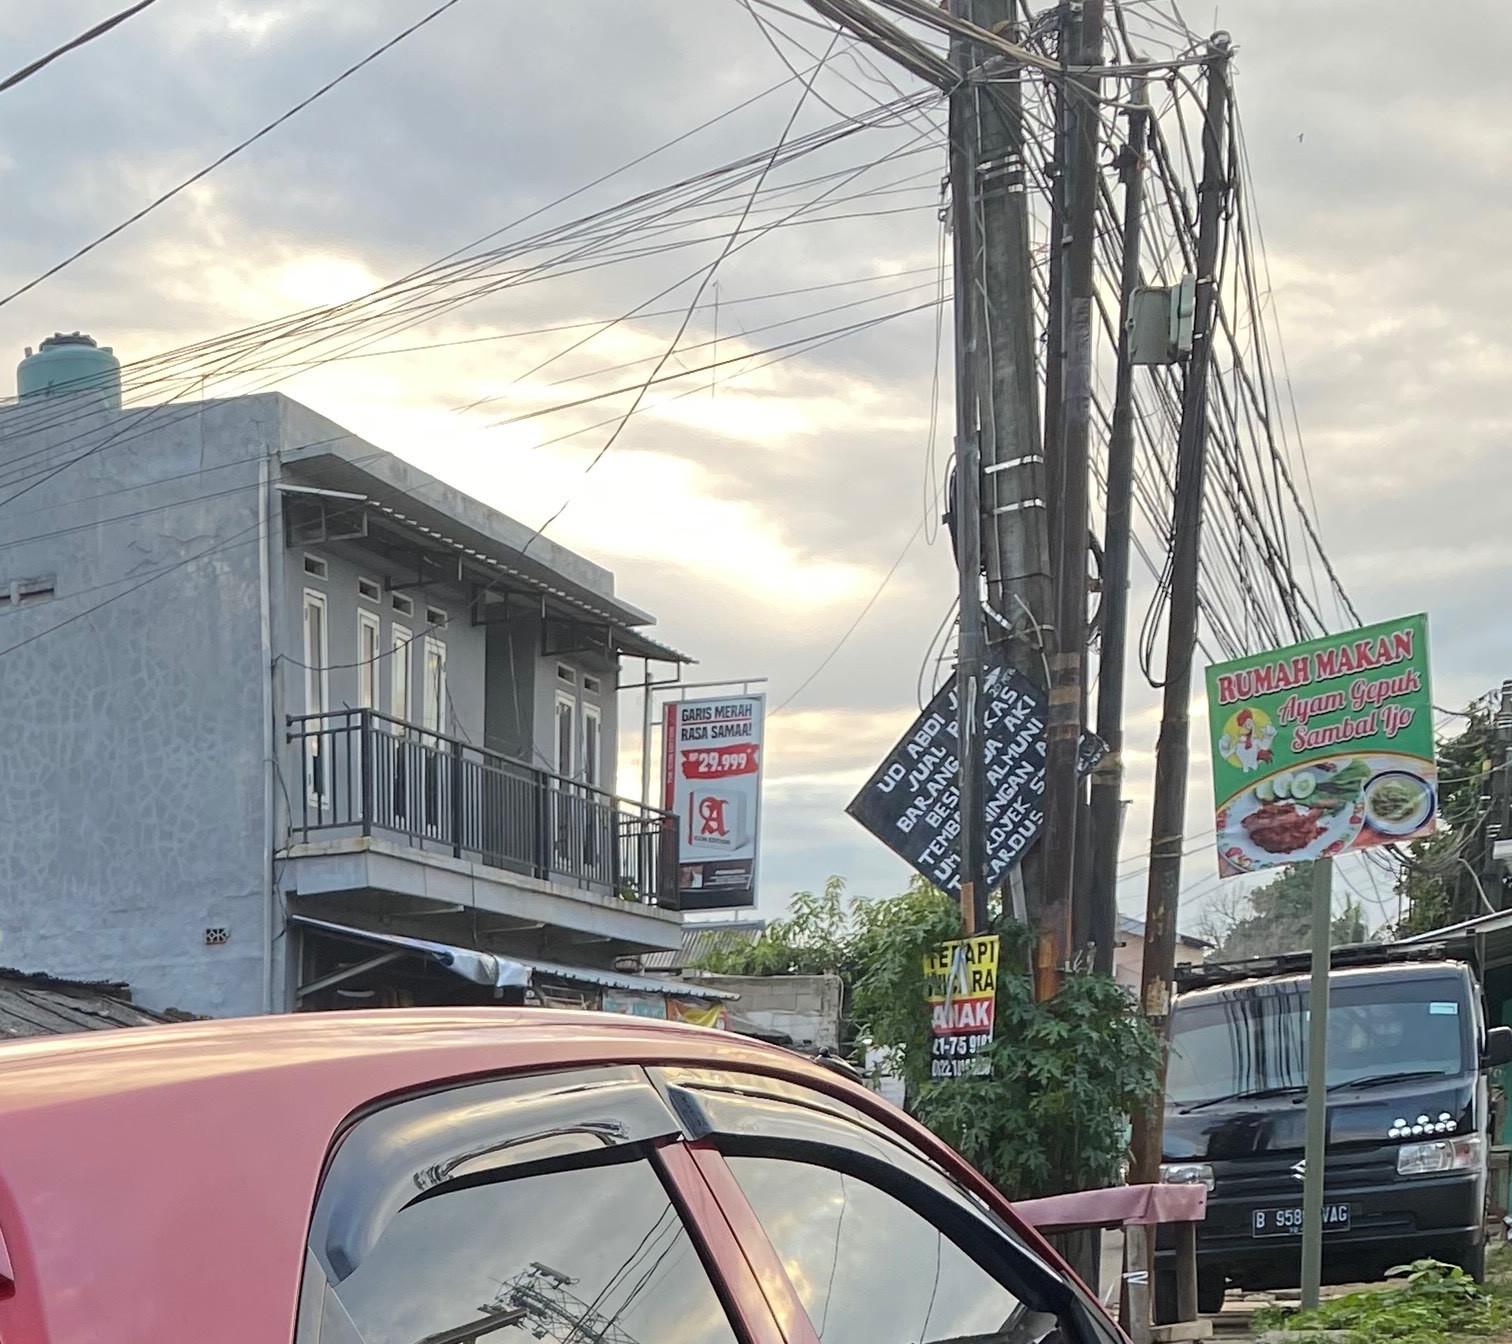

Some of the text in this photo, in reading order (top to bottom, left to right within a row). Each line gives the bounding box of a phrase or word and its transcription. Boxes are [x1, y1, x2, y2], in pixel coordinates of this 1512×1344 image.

[1218, 628, 1414, 706] RUMAH MAKAN
[682, 704, 752, 722] GARIS MERAH
[1278, 668, 1422, 726] Ayam Gepuk
[681, 722, 752, 741] RASA SAMAA!
[877, 712, 946, 793] UD ABDI
[987, 717, 1044, 787] ALMUNI
[1292, 705, 1416, 752] Sambal Ijo
[908, 746, 946, 793] JUAL
[925, 788, 961, 829] BESI
[1003, 695, 1036, 732] AKI
[896, 757, 960, 833] BARANG
[986, 810, 1044, 885] ARDUS
[932, 1001, 992, 1029] ANAK
[1256, 1212, 1265, 1228] B
[1276, 1209, 1304, 1227] 958
